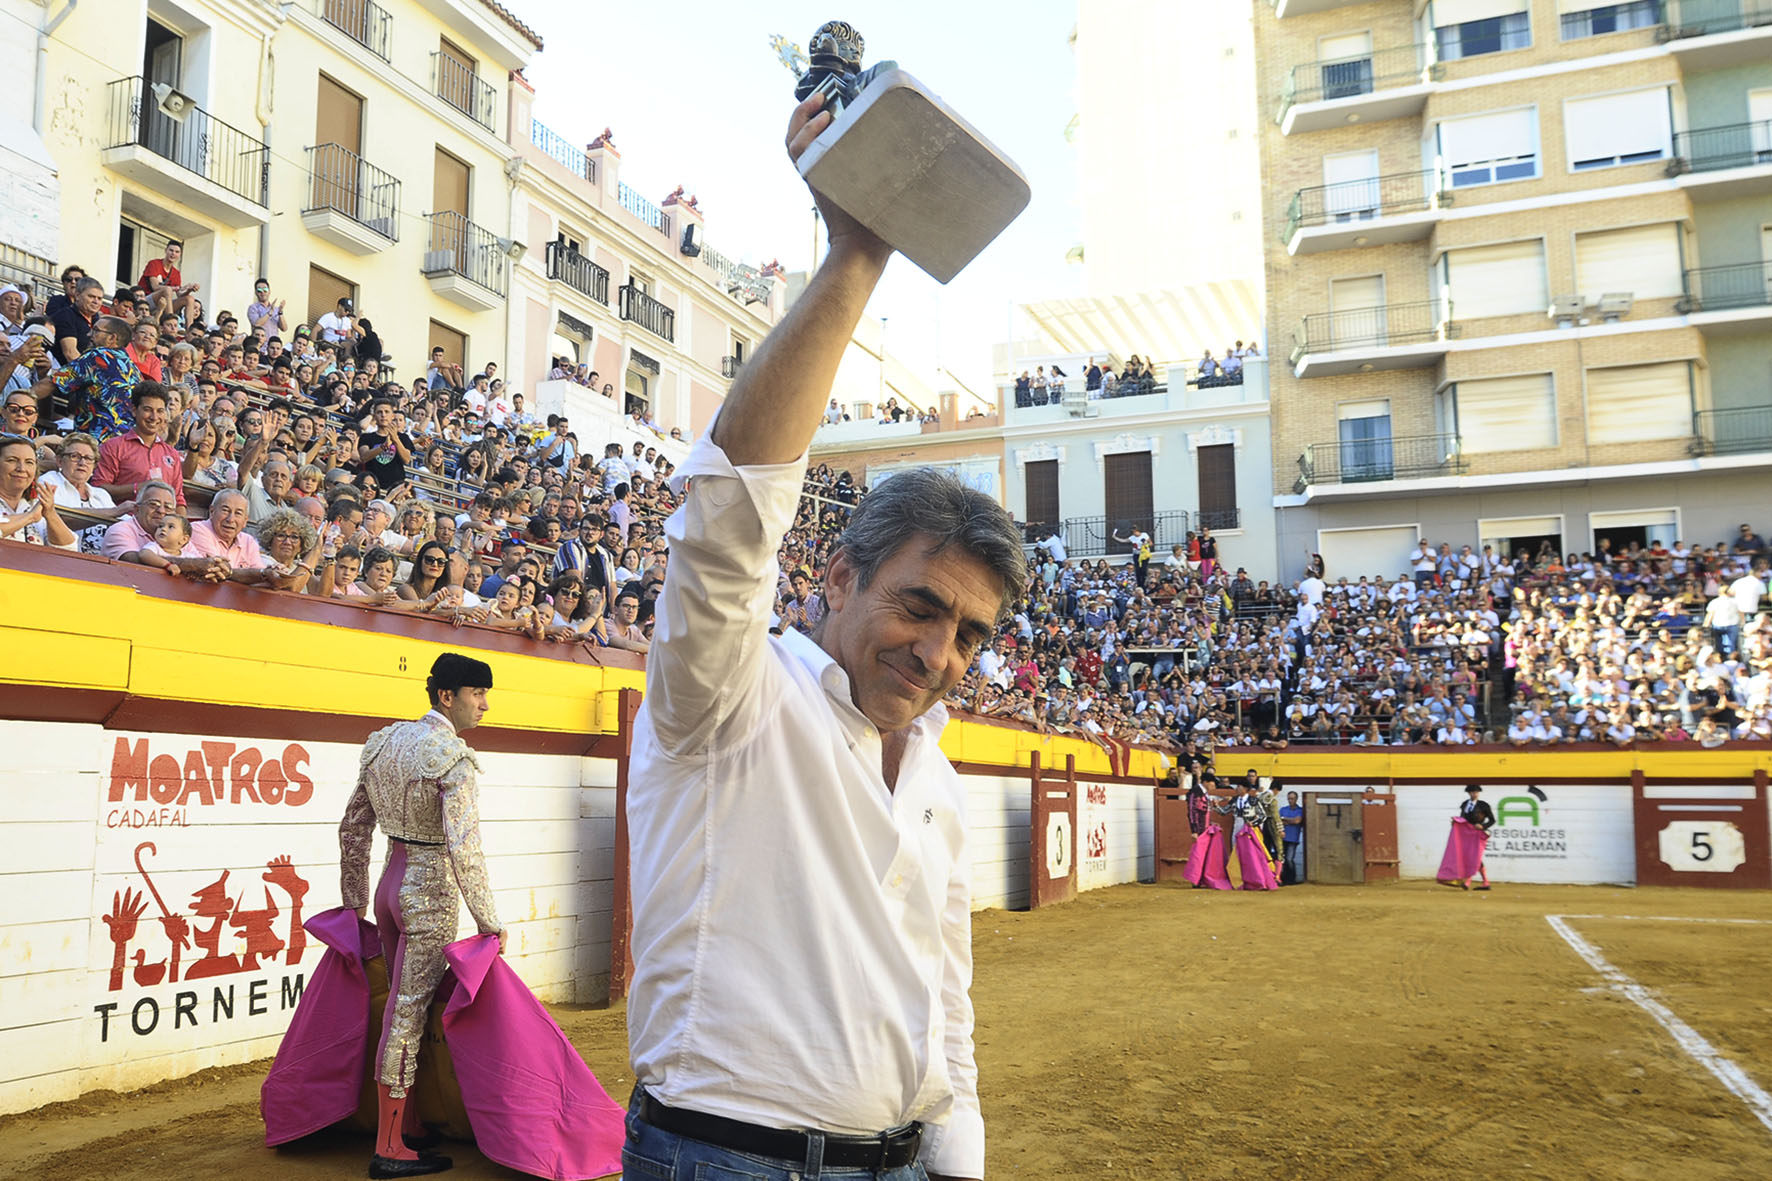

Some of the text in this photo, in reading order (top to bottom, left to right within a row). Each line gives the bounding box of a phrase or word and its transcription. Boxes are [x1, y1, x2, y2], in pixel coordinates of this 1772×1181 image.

[399, 656, 407, 672] 8
[108, 737, 314, 807] MOATROS
[107, 808, 191, 829] CADAFAL
[1327, 804, 1341, 829] 4
[1056, 825, 1063, 866] 3
[1692, 832, 1713, 861] 5
[94, 973, 304, 1043] TORNEM
